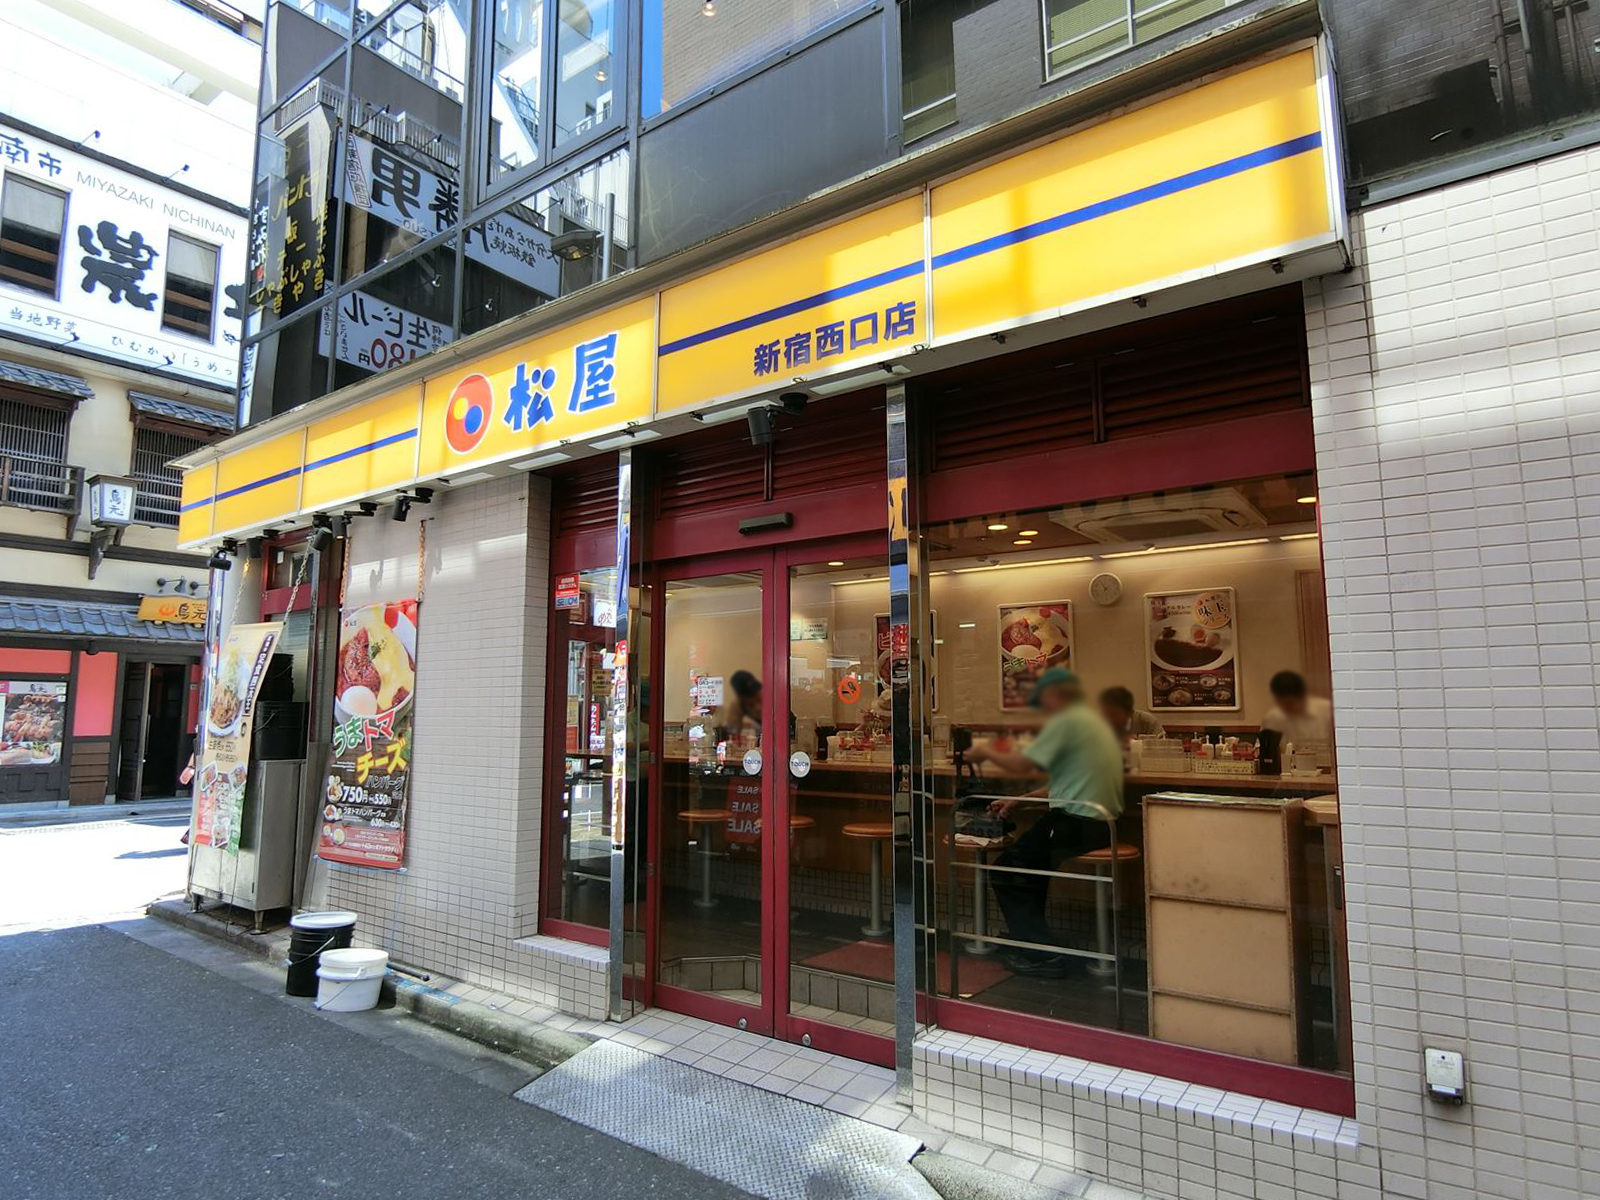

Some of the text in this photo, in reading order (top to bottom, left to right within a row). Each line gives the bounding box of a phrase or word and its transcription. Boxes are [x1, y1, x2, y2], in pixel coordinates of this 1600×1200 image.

[77, 171, 154, 209] MIYAZAKI
[163, 203, 236, 240] NICHINAN
[753, 300, 916, 376] 新宿西口店
[503, 333, 618, 431] 松屋
[333, 710, 396, 758] うまトマ
[356, 738, 408, 784] チーズ
